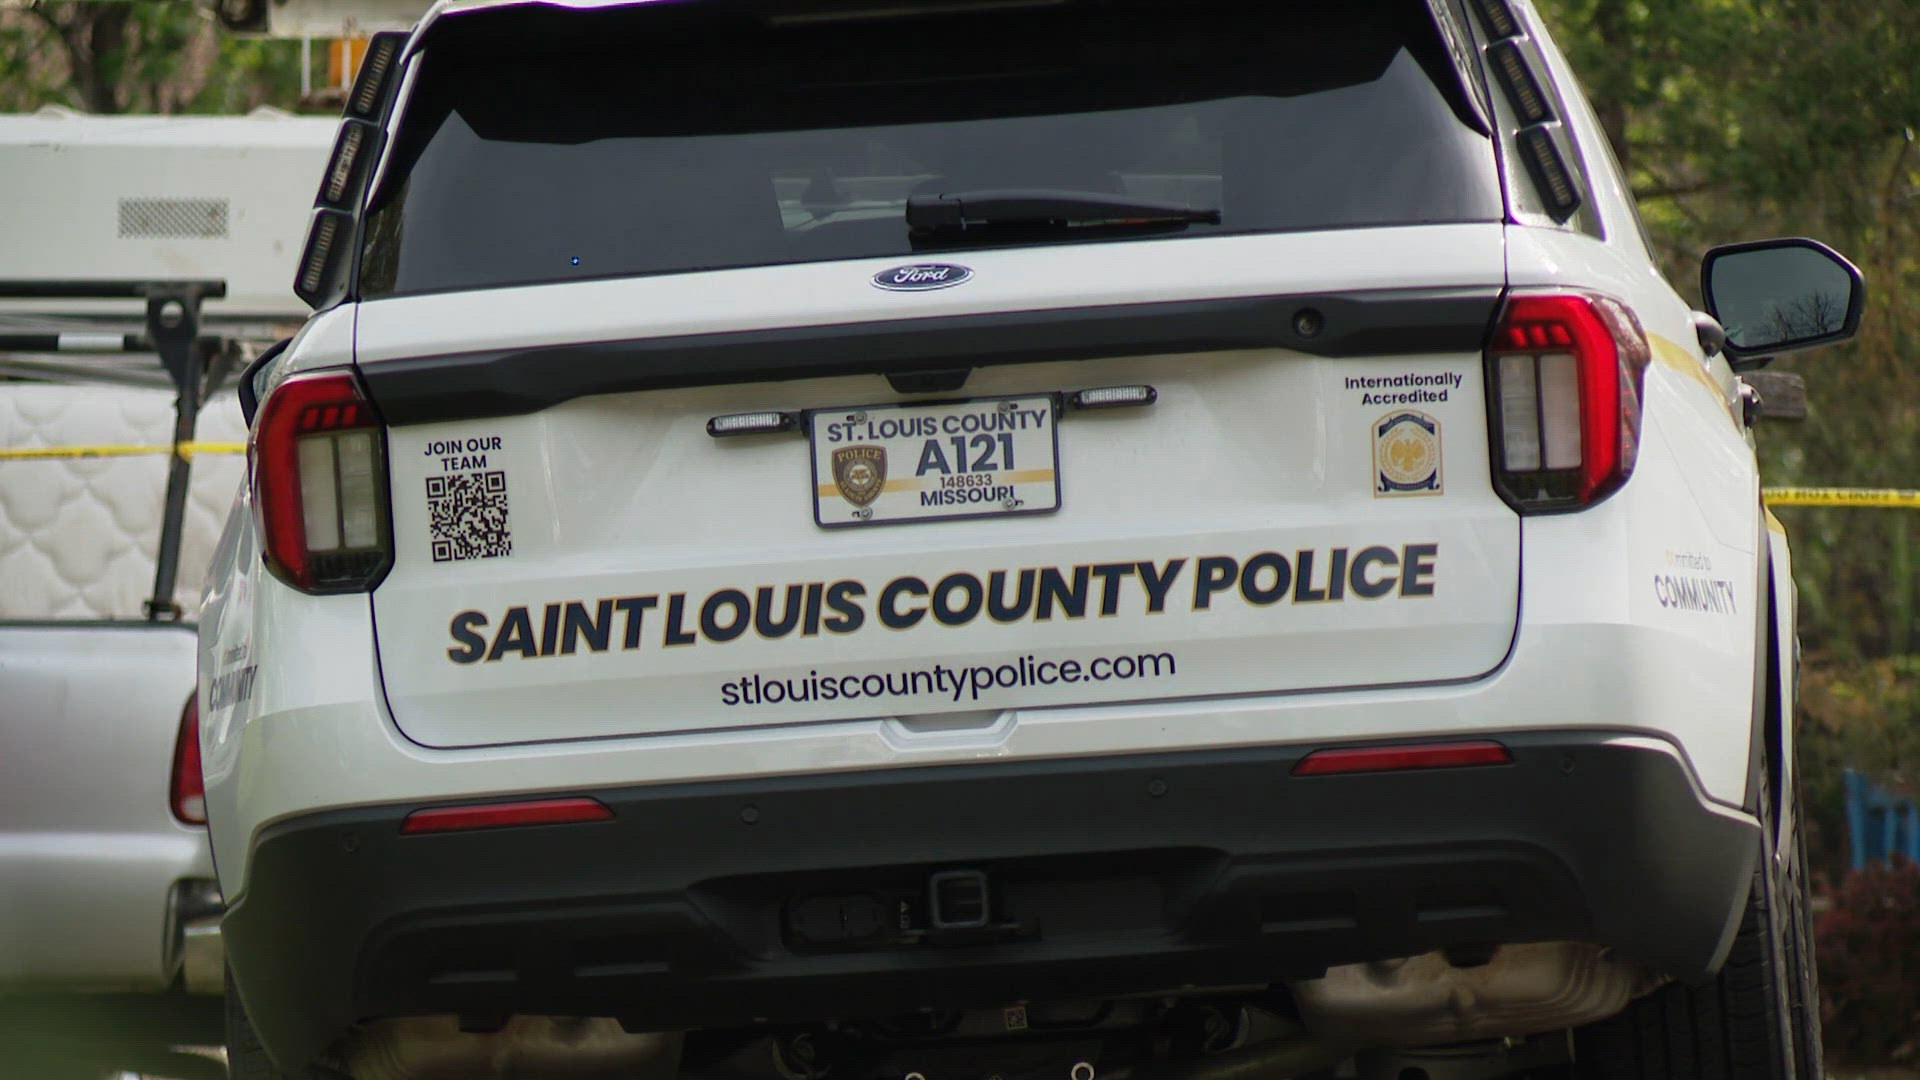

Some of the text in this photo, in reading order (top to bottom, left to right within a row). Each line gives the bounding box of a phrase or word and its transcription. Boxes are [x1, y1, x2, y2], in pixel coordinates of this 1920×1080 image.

[893, 267, 950, 283] Ford
[1345, 372, 1462, 389] Internationally
[1362, 389, 1449, 405] Accredited
[828, 409, 1047, 442] ST. LOUIS COUNTY
[424, 437, 502, 456] JOIN OUR
[838, 448, 882, 463] POLICE
[915, 433, 1015, 476] A121
[441, 454, 487, 471] TEAM
[940, 473, 993, 489] 148633
[920, 485, 1014, 507] MISSOURI
[1654, 574, 1737, 614] COMMUNITY
[447, 543, 1439, 665] SAINT LOUIS COUNTY POLICE
[721, 649, 1176, 706] stlouiscountypolice.com
